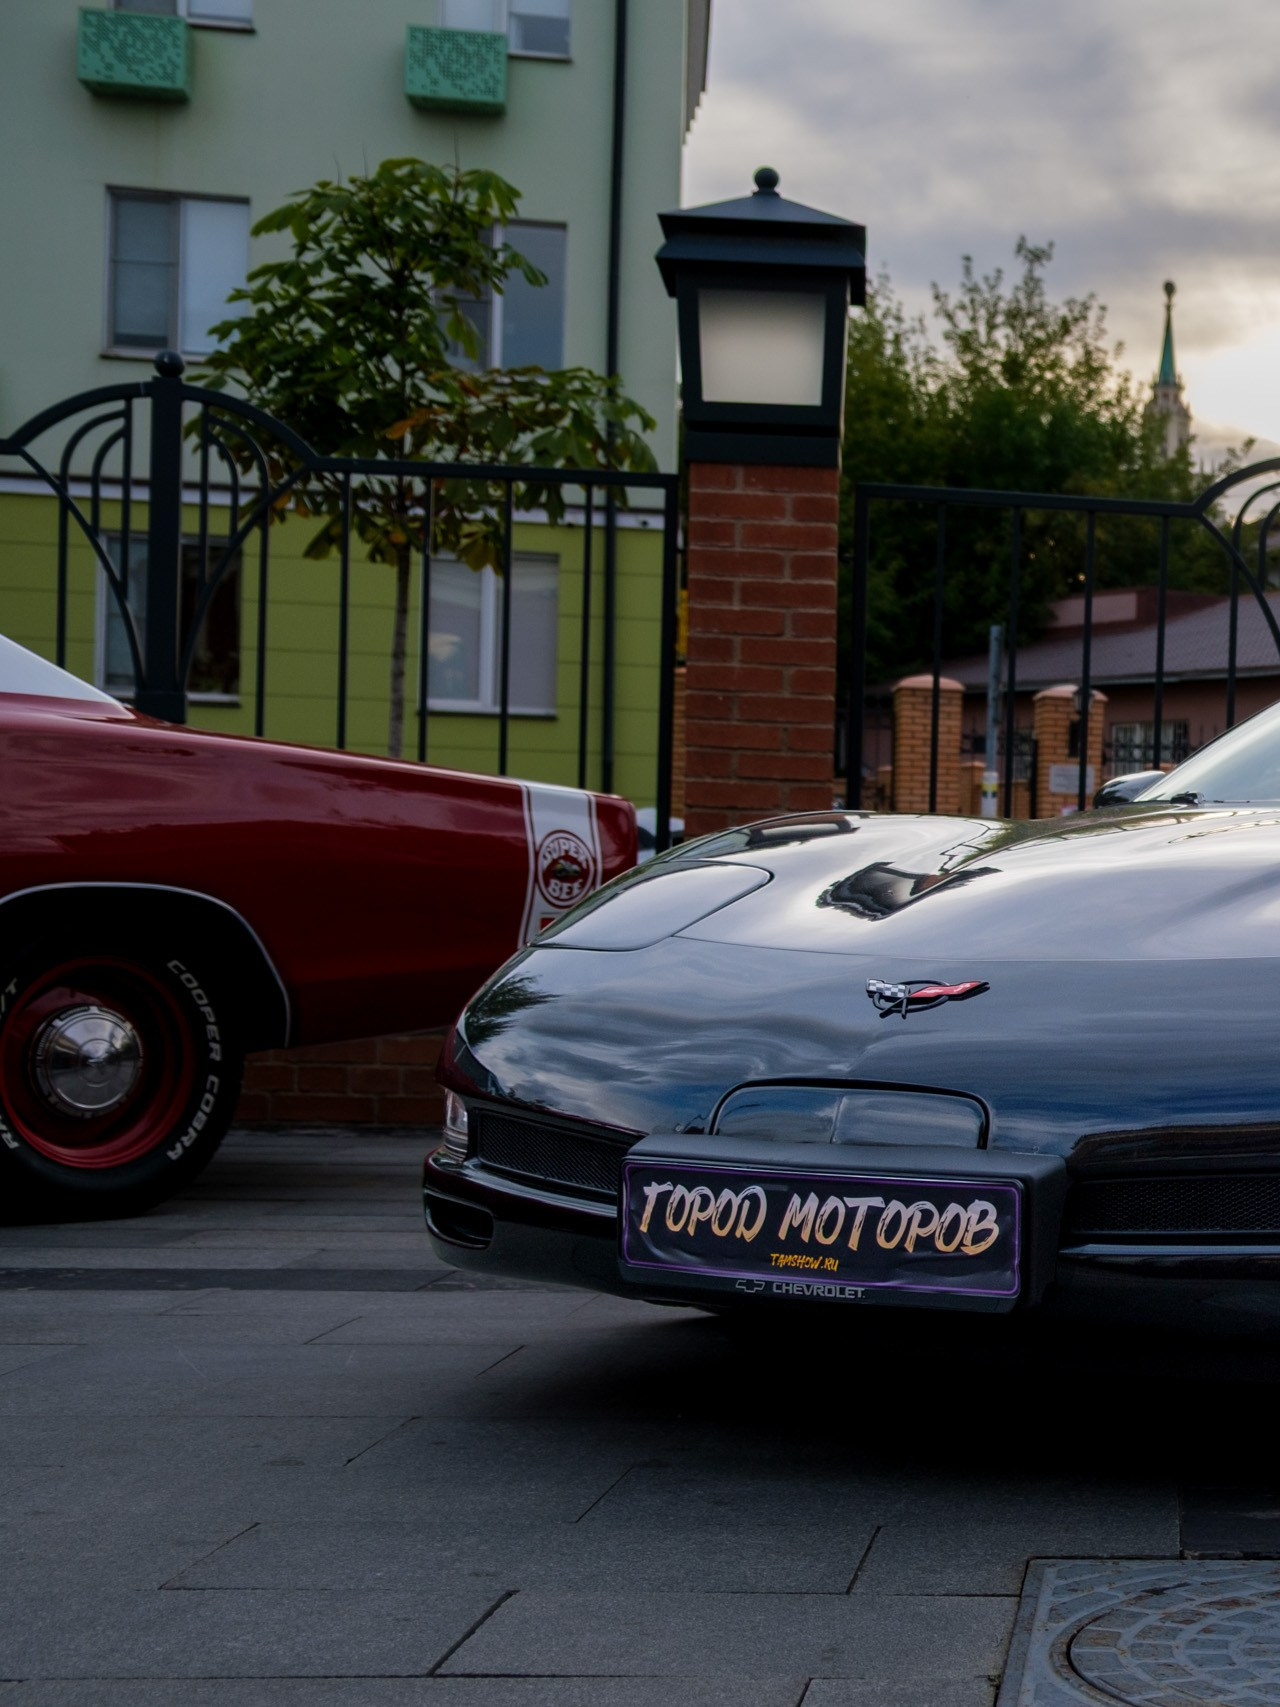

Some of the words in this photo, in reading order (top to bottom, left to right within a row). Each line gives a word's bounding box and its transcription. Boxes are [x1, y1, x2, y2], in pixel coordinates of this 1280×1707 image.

[547, 878, 584, 899] BEE
[166, 959, 222, 1062] COOPER
[166, 1073, 220, 1161] COBRA
[770, 1253, 839, 1272] TAMSHOW.RU
[772, 1282, 866, 1298] CHEVROLET
